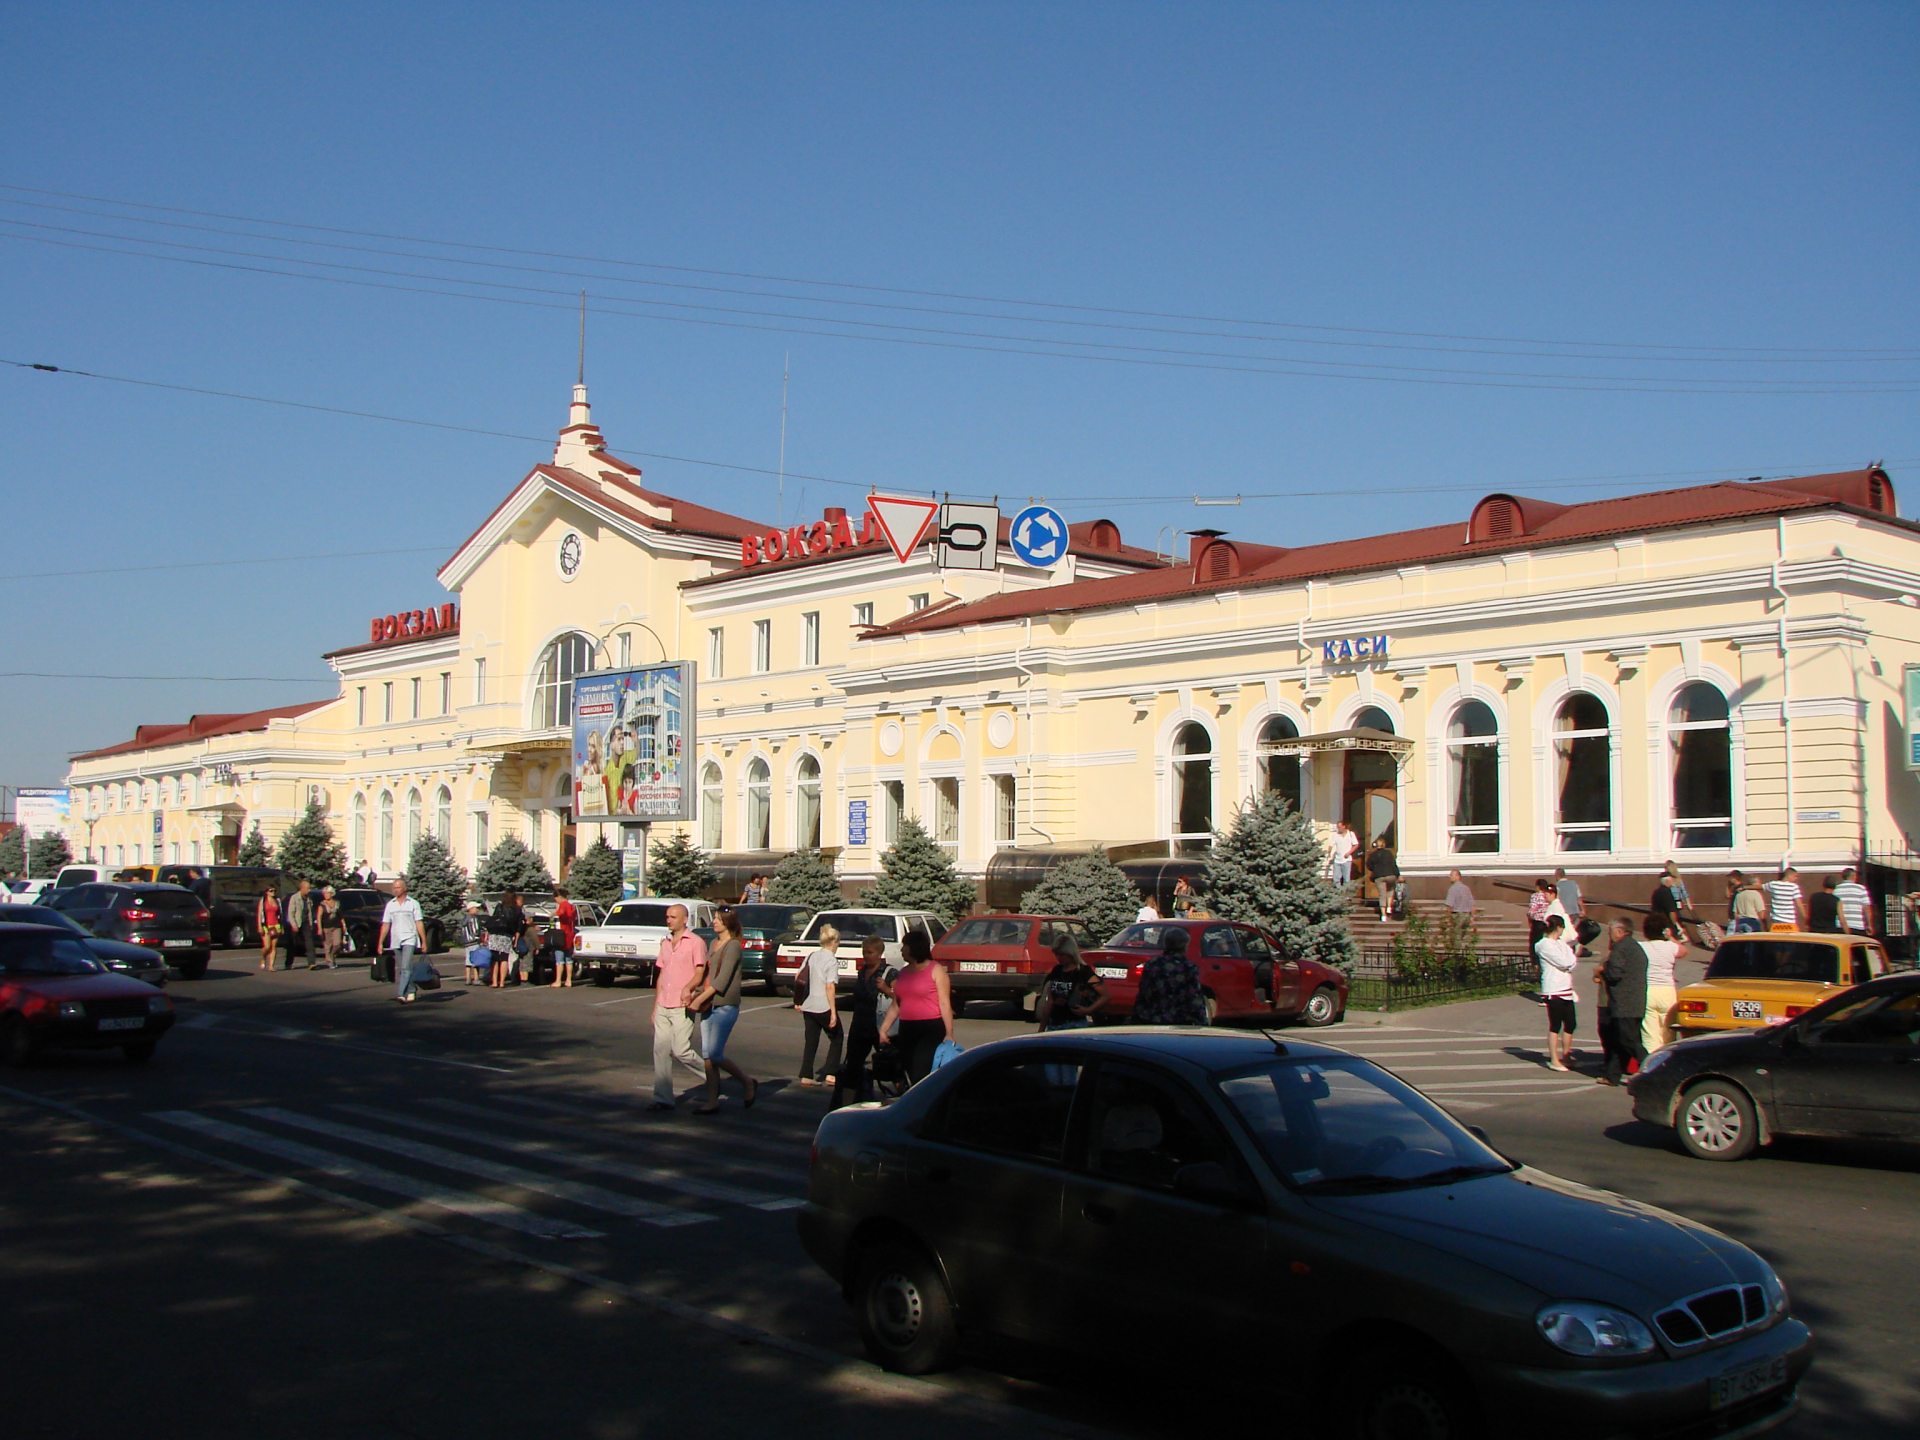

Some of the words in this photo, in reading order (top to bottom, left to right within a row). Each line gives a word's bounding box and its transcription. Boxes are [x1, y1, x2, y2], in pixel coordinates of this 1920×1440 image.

[742, 511, 884, 567] ВОКЗАЛ
[370, 602, 456, 641] ВОКЗАЛ
[1323, 634, 1388, 659] КАСИ
[1733, 1001, 1760, 1012] 92-09
